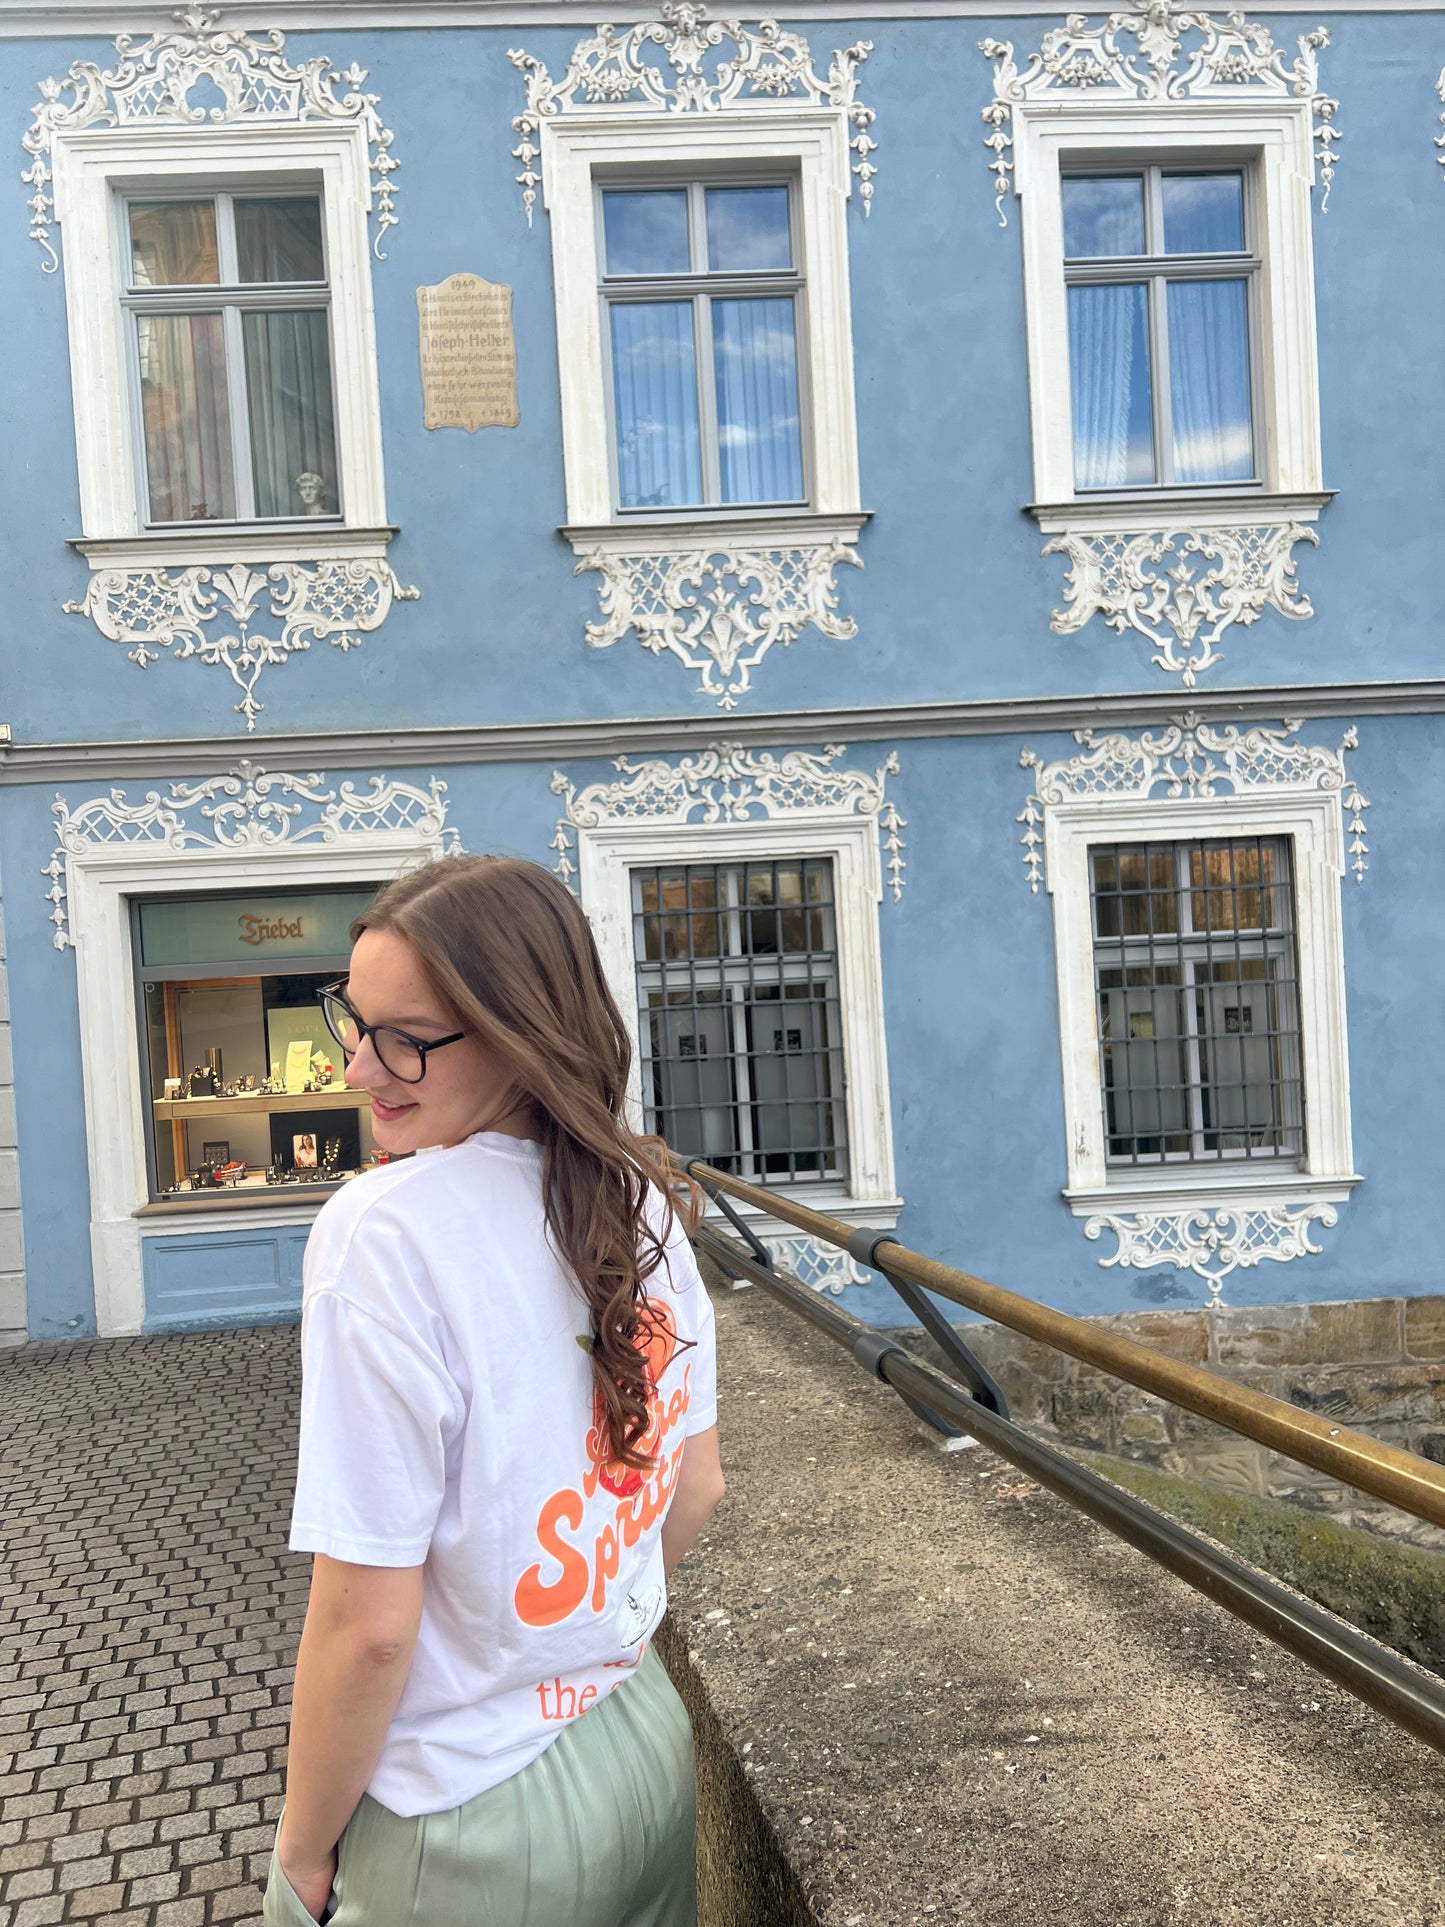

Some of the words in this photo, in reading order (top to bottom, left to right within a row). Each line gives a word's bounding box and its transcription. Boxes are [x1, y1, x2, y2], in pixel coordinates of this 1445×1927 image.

[451, 280, 476, 290] 1949
[238, 913, 304, 946] Triebel
[536, 1677, 598, 1721] the
